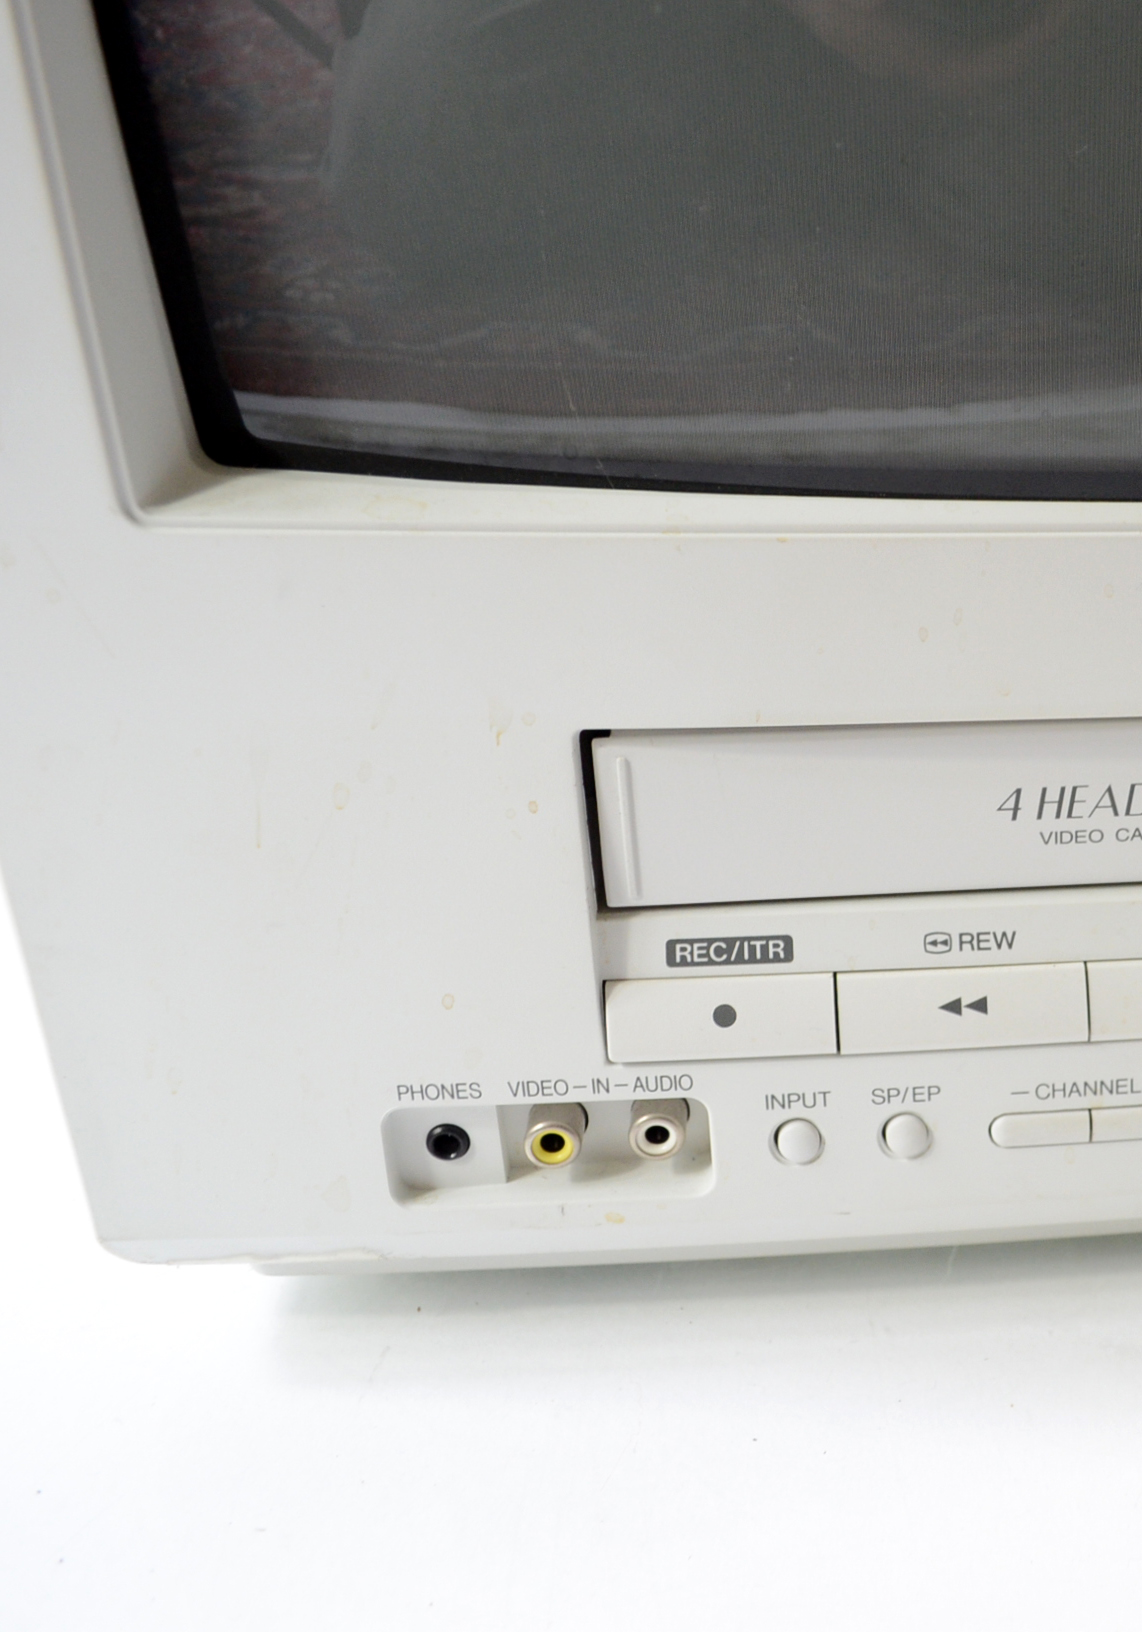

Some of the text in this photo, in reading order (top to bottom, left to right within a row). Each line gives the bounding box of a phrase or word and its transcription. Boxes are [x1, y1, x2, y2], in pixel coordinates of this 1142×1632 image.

[996, 787, 1023, 822] 4
[1039, 828, 1106, 846] VIDEO
[674, 939, 786, 964] REC/ITR
[958, 930, 1017, 952] REW
[396, 1081, 483, 1102] PHONES
[871, 1084, 942, 1106] SP/EP
[1034, 1077, 1142, 1101] CHANNEL
[764, 1090, 831, 1111] INPUT
